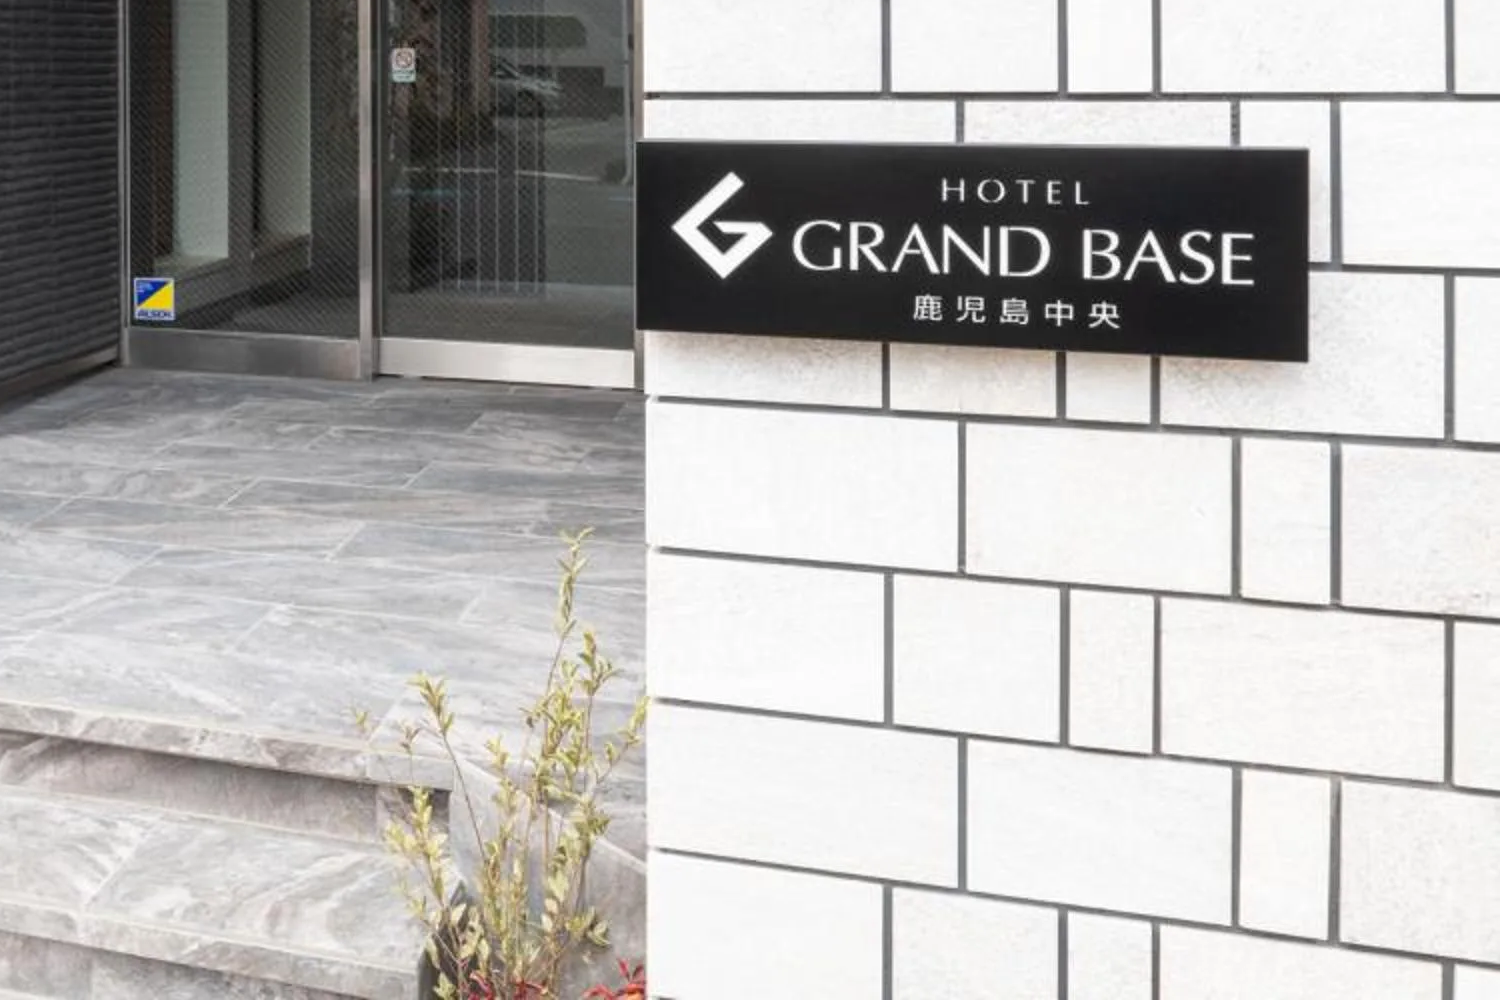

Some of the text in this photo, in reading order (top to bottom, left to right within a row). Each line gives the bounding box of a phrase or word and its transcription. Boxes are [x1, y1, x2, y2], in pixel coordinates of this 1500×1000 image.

[941, 178, 1089, 205] HOTEL
[791, 219, 1255, 286] GRAND BASE
[913, 293, 1120, 329] 鹿児島中央
